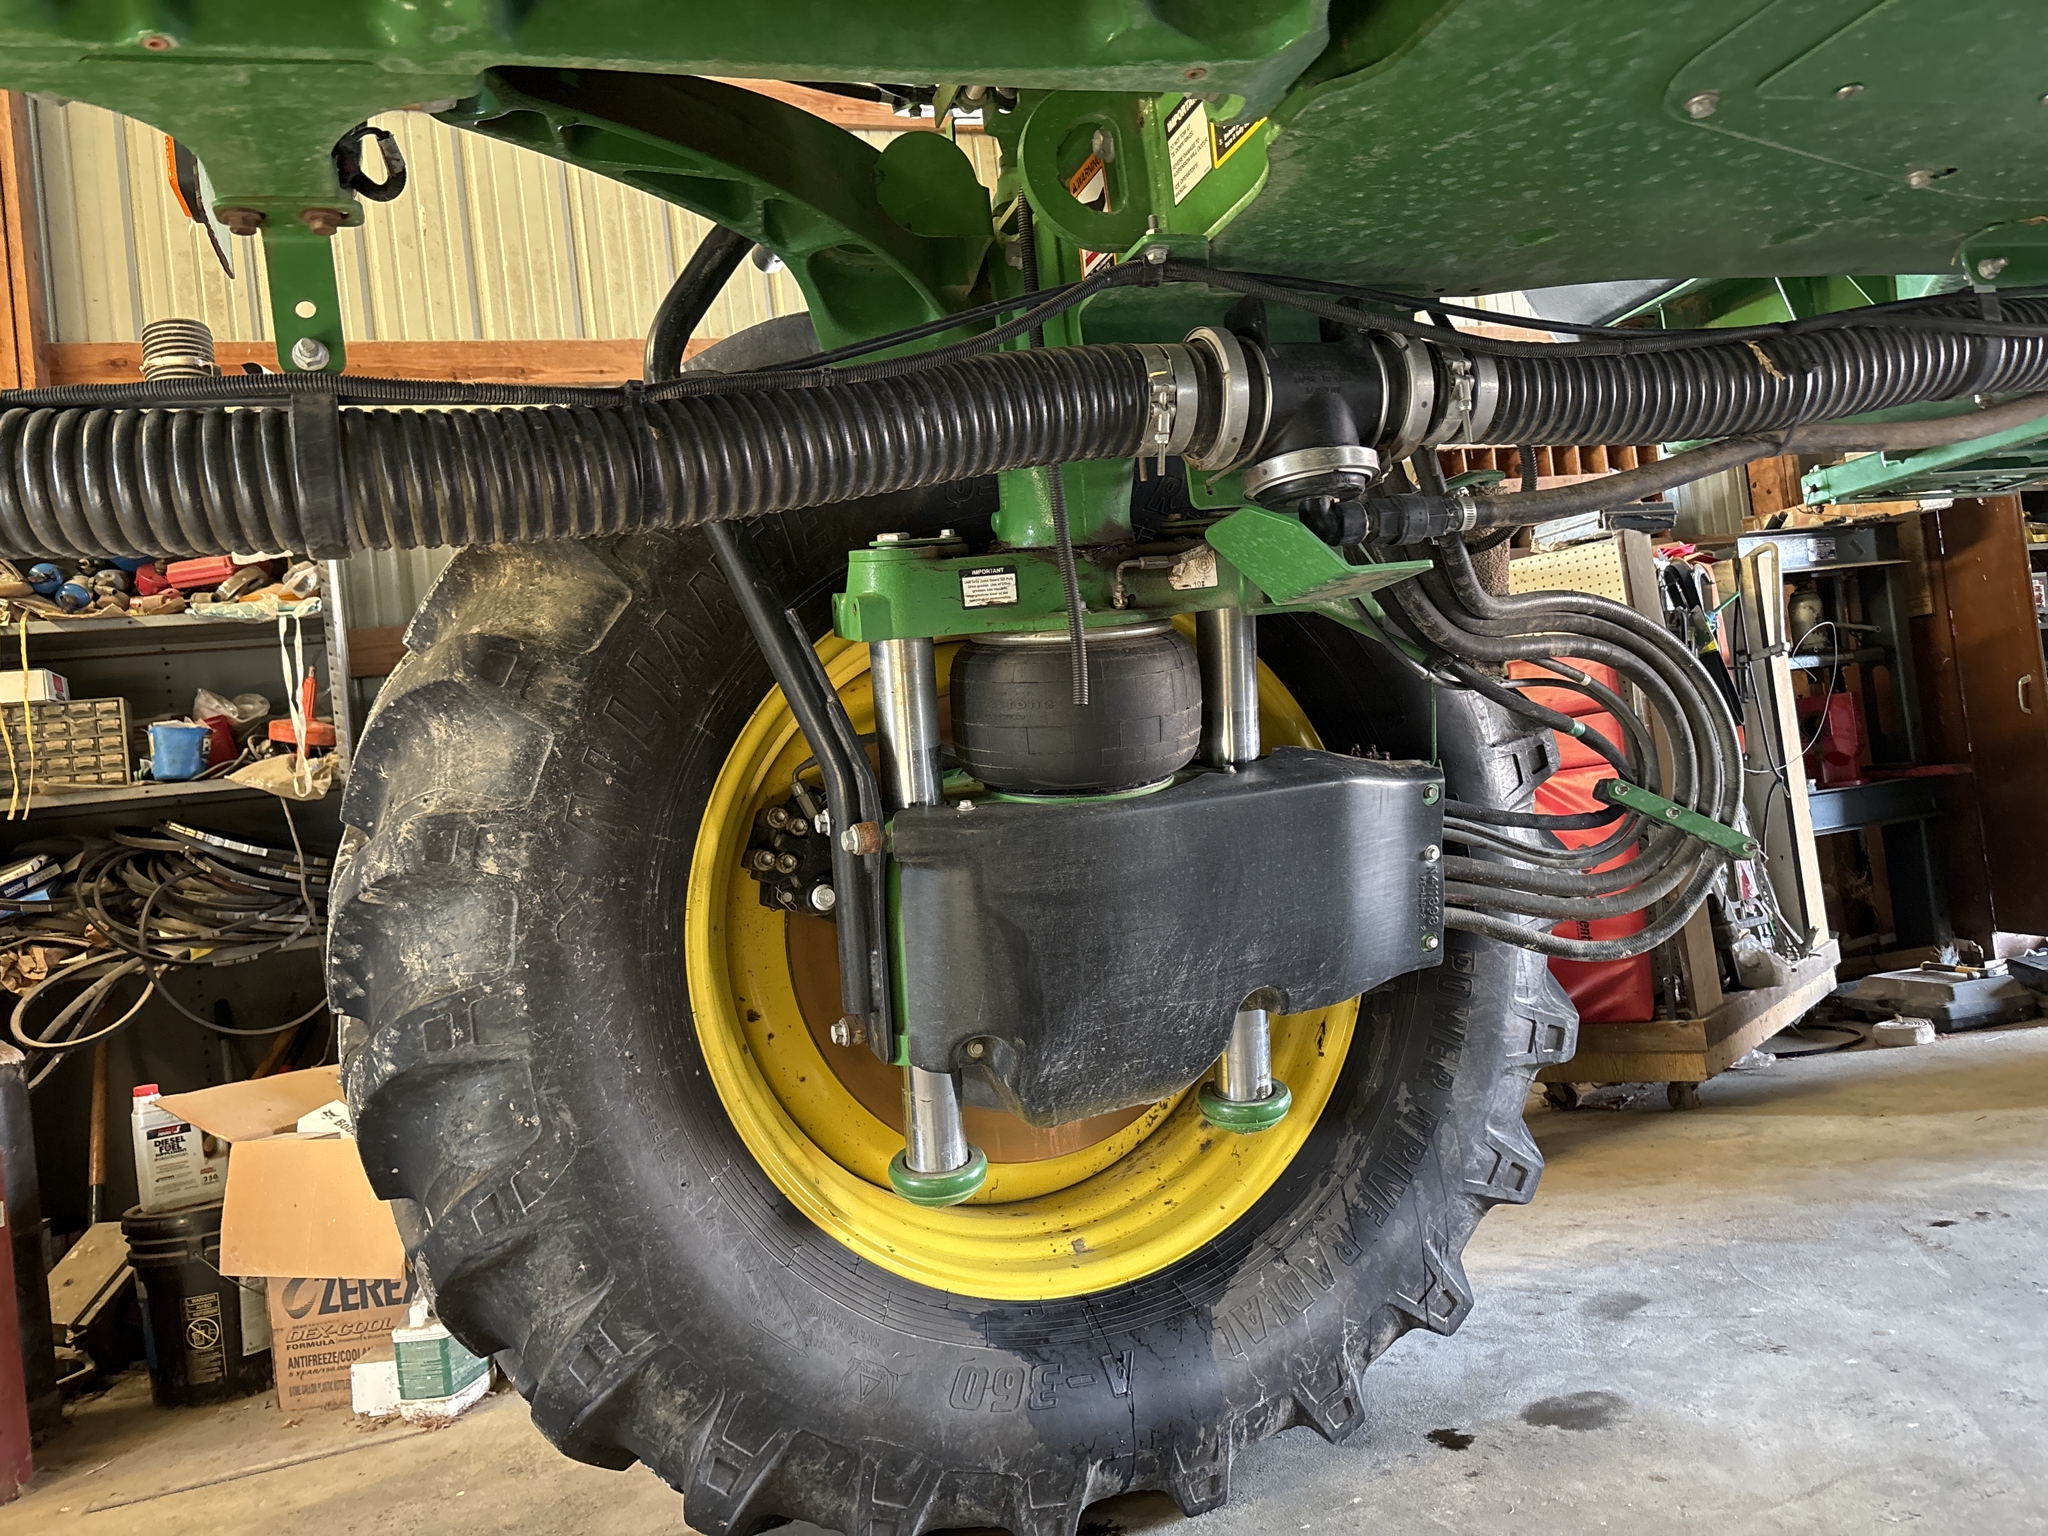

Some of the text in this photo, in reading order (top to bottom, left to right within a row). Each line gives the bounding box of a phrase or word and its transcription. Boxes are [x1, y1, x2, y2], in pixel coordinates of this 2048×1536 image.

[1166, 98, 1198, 133] IMPORTA
[971, 567, 1004, 575] IMPORTANT
[154, 1135, 186, 1148] DIESEL
[159, 1144, 182, 1153] FUEL
[1211, 946, 1477, 1358] POWER DRIVE RADIAL
[286, 1317, 395, 1343] DEX-COOL
[807, 1302, 882, 1348] SAFETY WARNING
[286, 1339, 335, 1351] FORMULA
[288, 1345, 374, 1370] ANTIFREEZE/COOLA
[949, 1349, 1135, 1412] A-360
